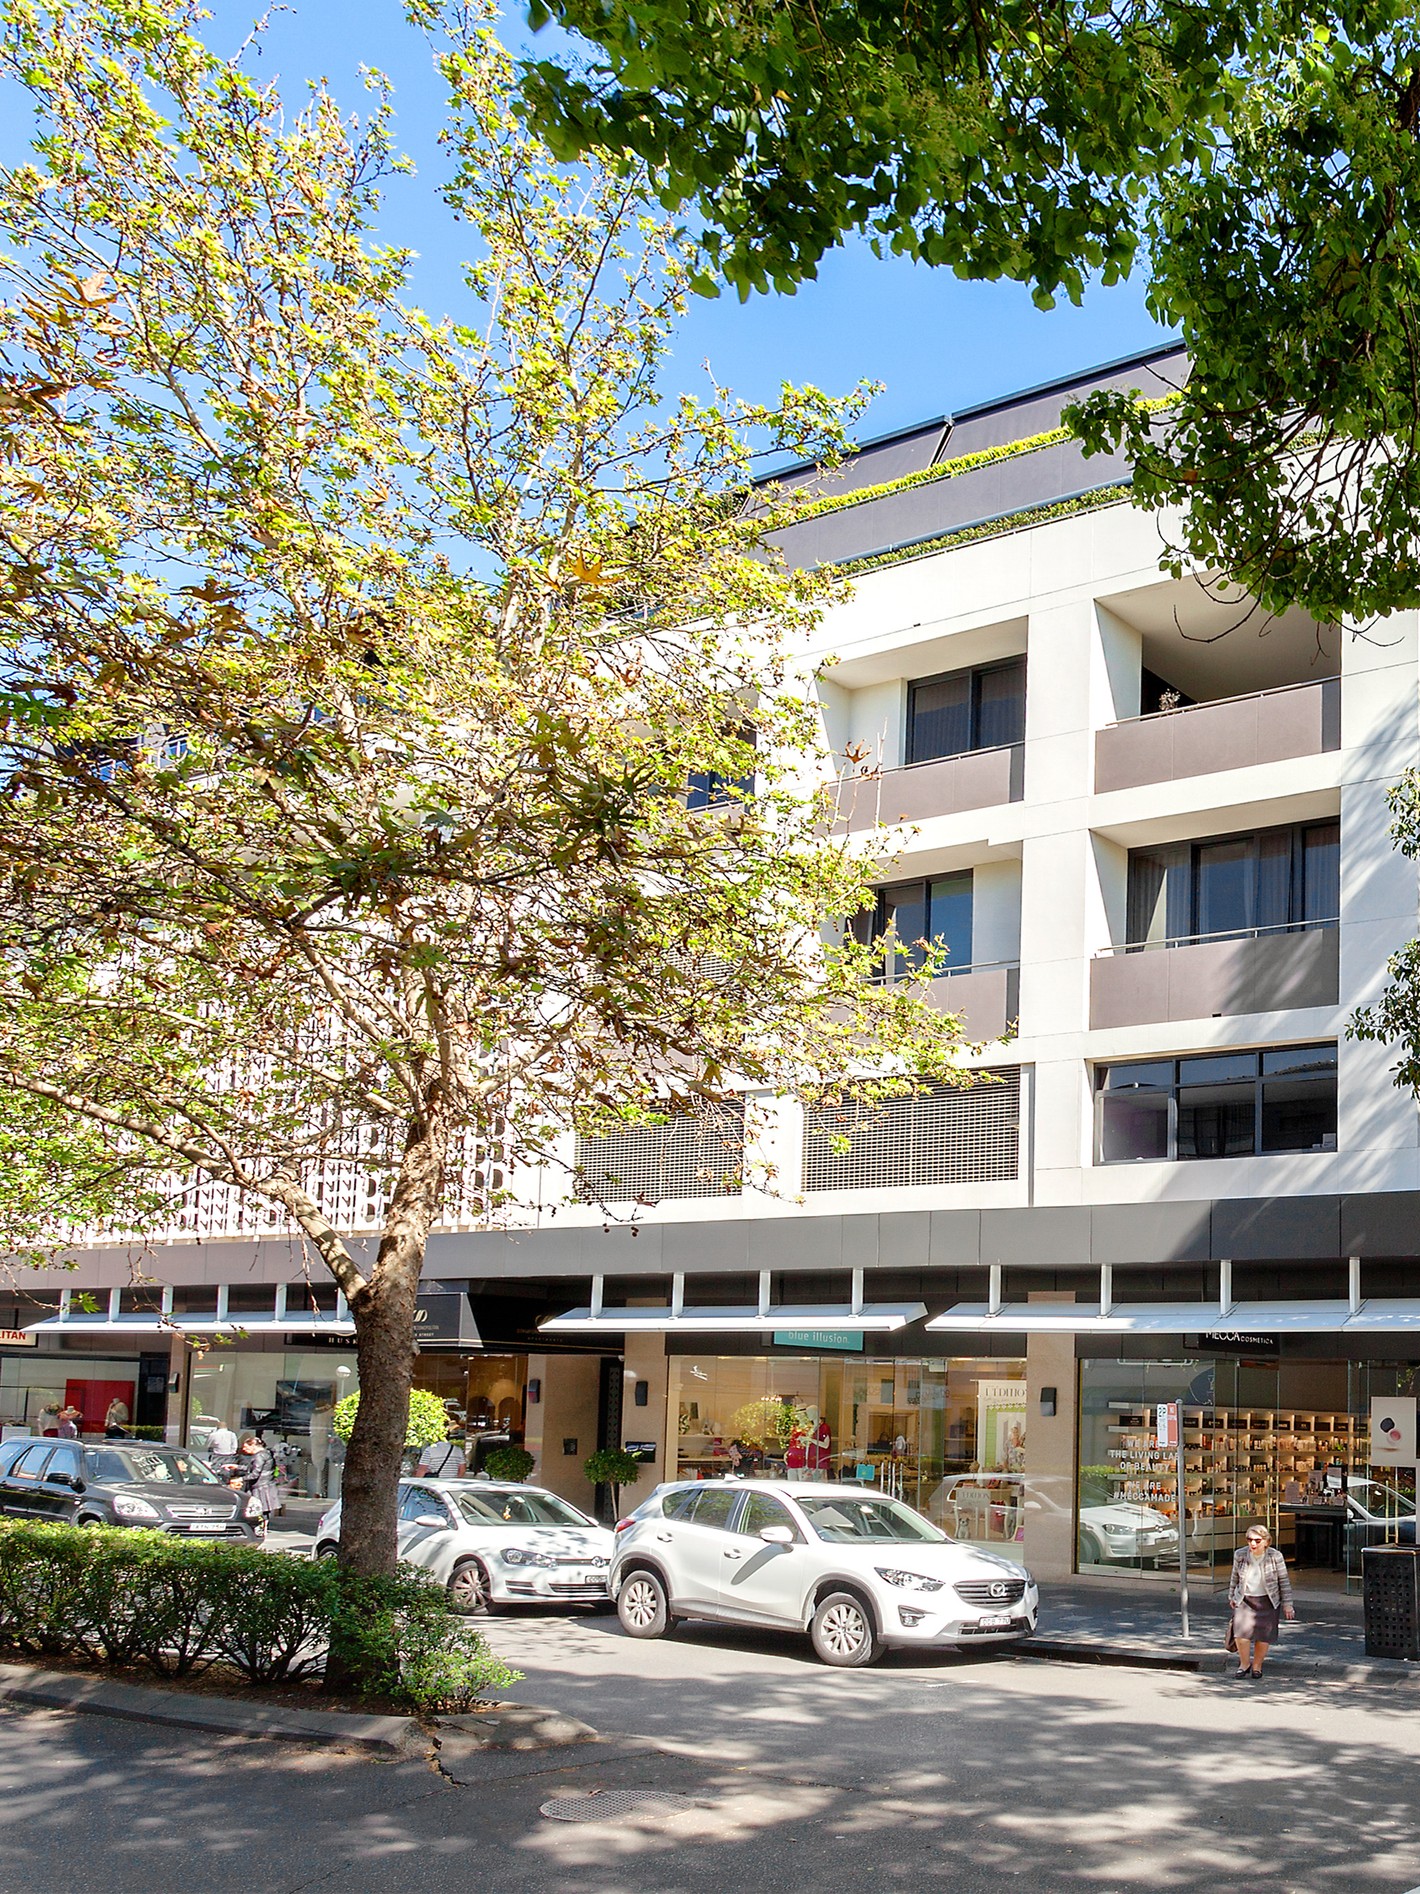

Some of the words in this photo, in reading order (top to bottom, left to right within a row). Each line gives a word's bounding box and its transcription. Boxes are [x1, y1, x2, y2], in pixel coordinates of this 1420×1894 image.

[0, 1331, 27, 1340] ITAN
[788, 1331, 809, 1341] blue
[813, 1332, 848, 1344] illusion
[1205, 1332, 1240, 1342] MECCA
[1126, 1438, 1140, 1448] WE
[1110, 1449, 1128, 1459] THE
[1130, 1451, 1160, 1460] LIVING
[1120, 1462, 1131, 1470] OF
[1113, 1491, 1176, 1503] #MECCAMADE
